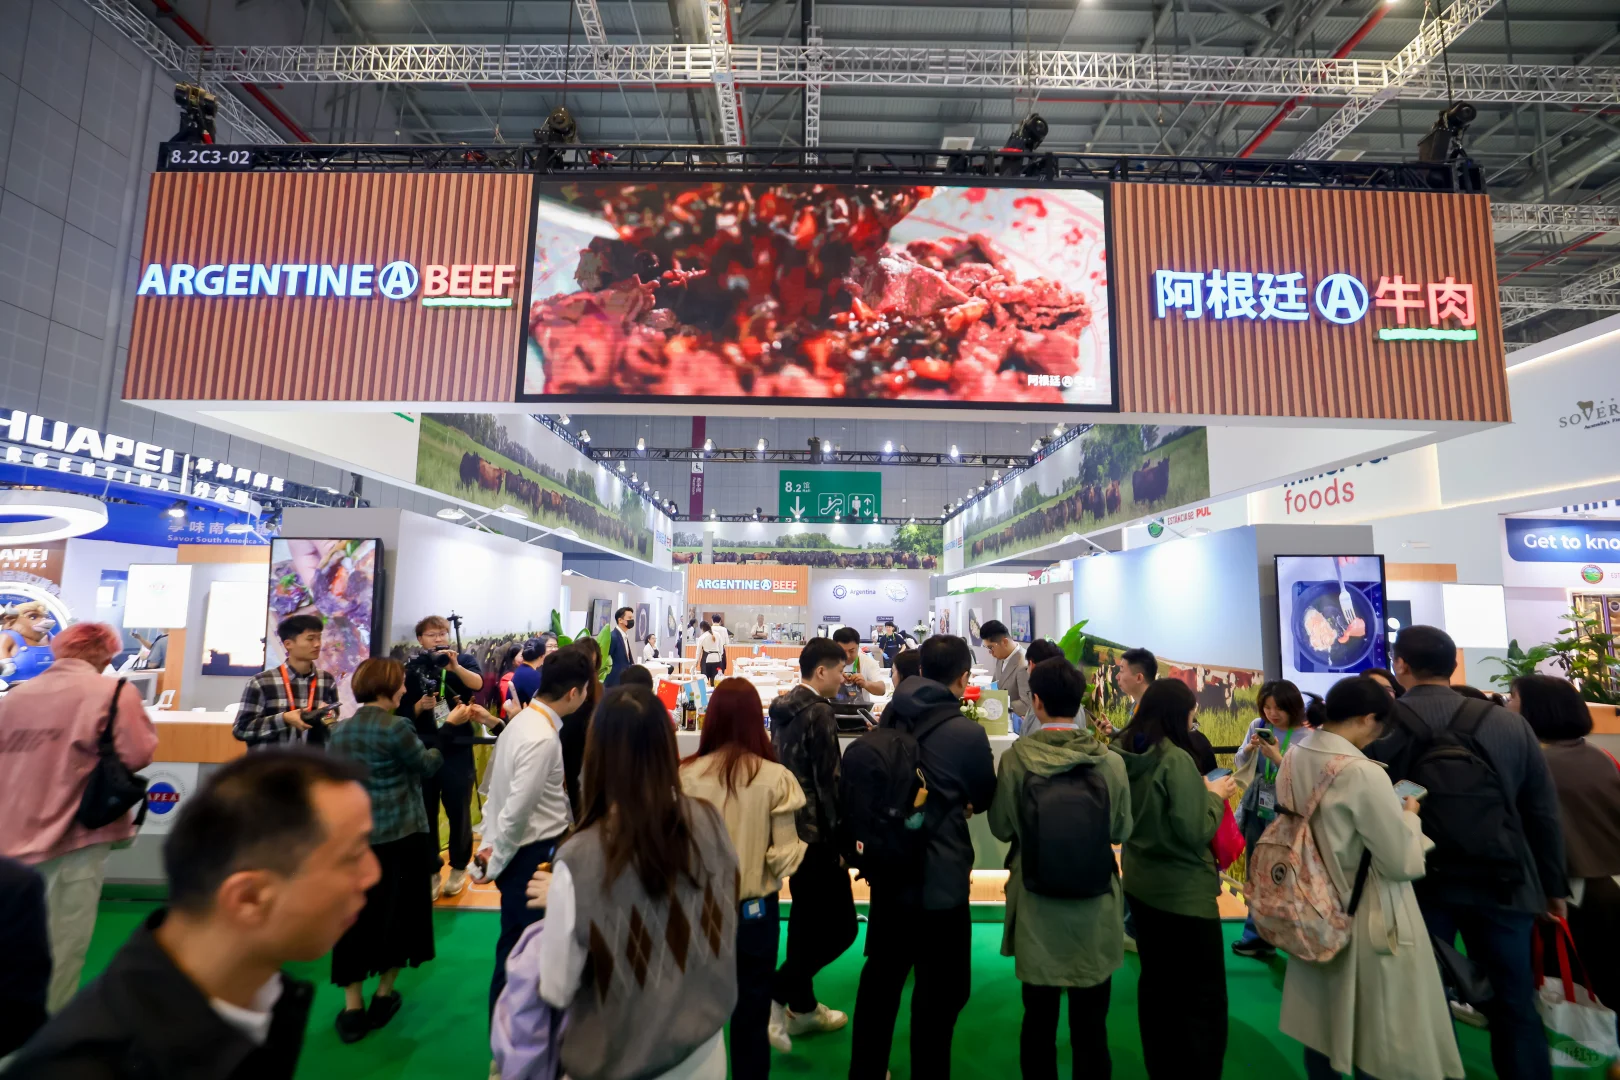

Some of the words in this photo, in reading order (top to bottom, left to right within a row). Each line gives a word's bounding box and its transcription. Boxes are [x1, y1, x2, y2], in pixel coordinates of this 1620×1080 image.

[171, 149, 250, 164] 8.2C3-02
[136, 263, 374, 297] ARGENTINE
[423, 264, 517, 296] BEEF
[1154, 269, 1310, 321] 阿根廷
[1375, 275, 1477, 326] 牛肉
[785, 481, 802, 493] 8.2
[1284, 477, 1355, 515] foods
[1196, 506, 1211, 518] PUL
[167, 534, 194, 542] Savor
[196, 535, 220, 544] South
[223, 537, 257, 545] America
[1523, 533, 1558, 549] Get
[1560, 534, 1581, 549] to
[696, 579, 760, 590] ARGENTINE
[772, 580, 798, 590] BEEF
[849, 588, 876, 596] Argentina
